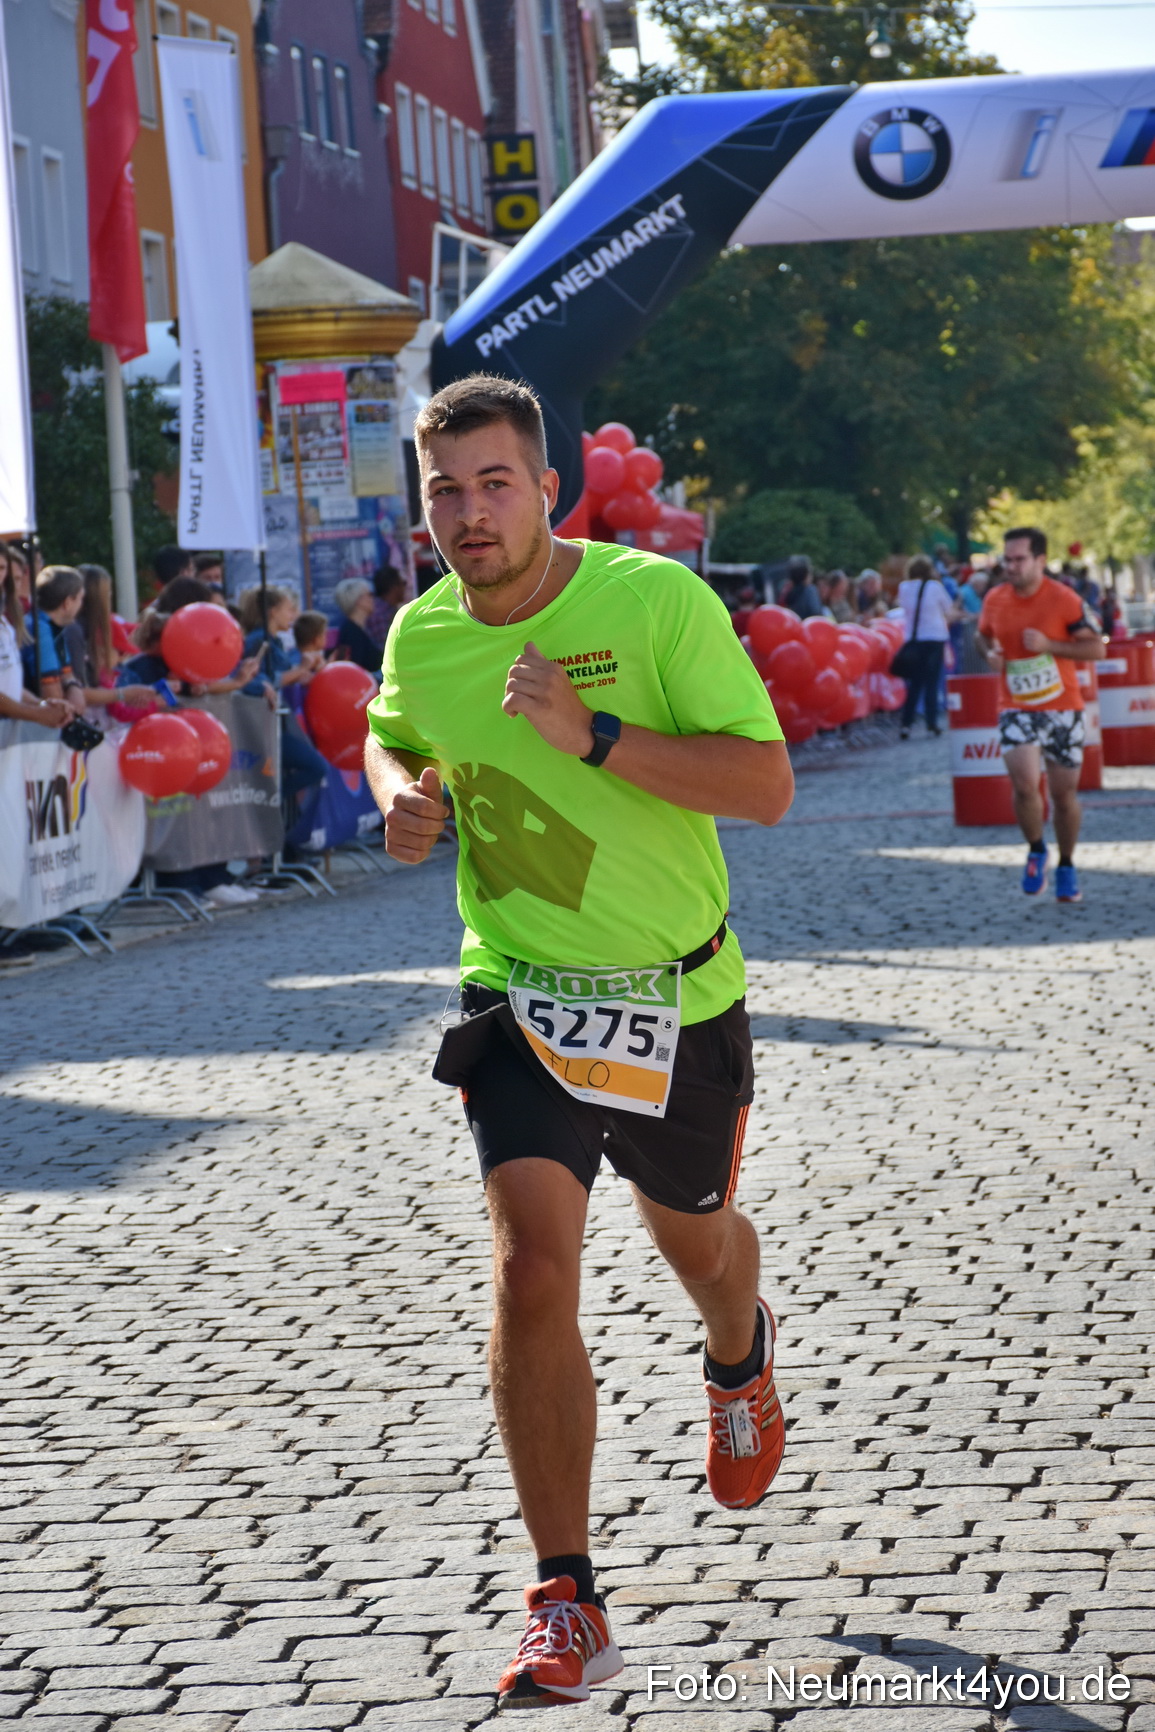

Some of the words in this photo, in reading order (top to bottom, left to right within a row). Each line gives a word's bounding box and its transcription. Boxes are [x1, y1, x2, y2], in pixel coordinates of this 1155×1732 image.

[475, 294, 558, 358] PARTL
[551, 193, 687, 301] NEUMARKT
[596, 677, 617, 687] 2019
[527, 999, 659, 1058] 5275
[544, 1046, 611, 1088] FLO
